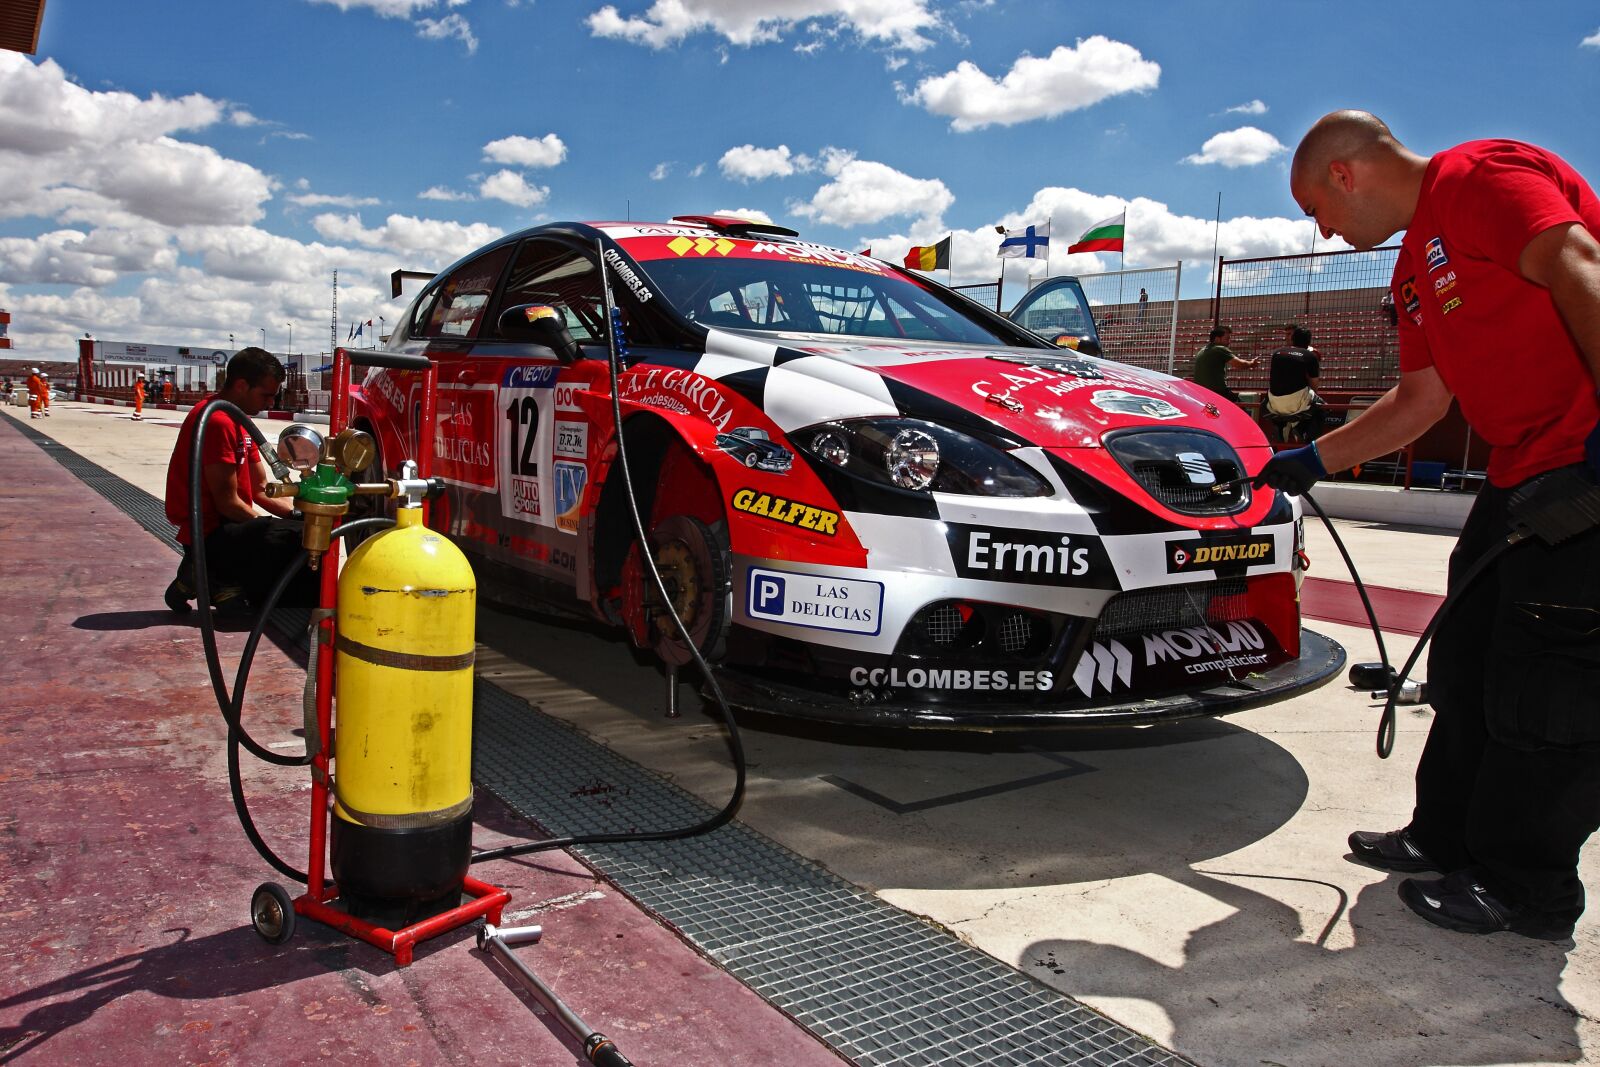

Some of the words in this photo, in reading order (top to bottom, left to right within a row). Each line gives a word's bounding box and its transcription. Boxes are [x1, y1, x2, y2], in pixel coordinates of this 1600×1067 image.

[604, 248, 653, 304] COLOMBES.ES
[450, 402, 472, 426] LAS
[662, 370, 733, 431] GARCIA
[507, 396, 540, 477] 12
[436, 437, 490, 466] DELICIAS
[513, 480, 539, 501] AUTO
[514, 497, 540, 514] SPORT
[733, 489, 839, 535] GALFER
[967, 531, 1090, 576] Ermis
[1193, 542, 1271, 564] DUNLOP
[760, 580, 779, 608] P
[816, 584, 849, 599] LAS
[792, 600, 872, 622] DELICIAS
[850, 666, 1054, 692] COLOMBES.ES
